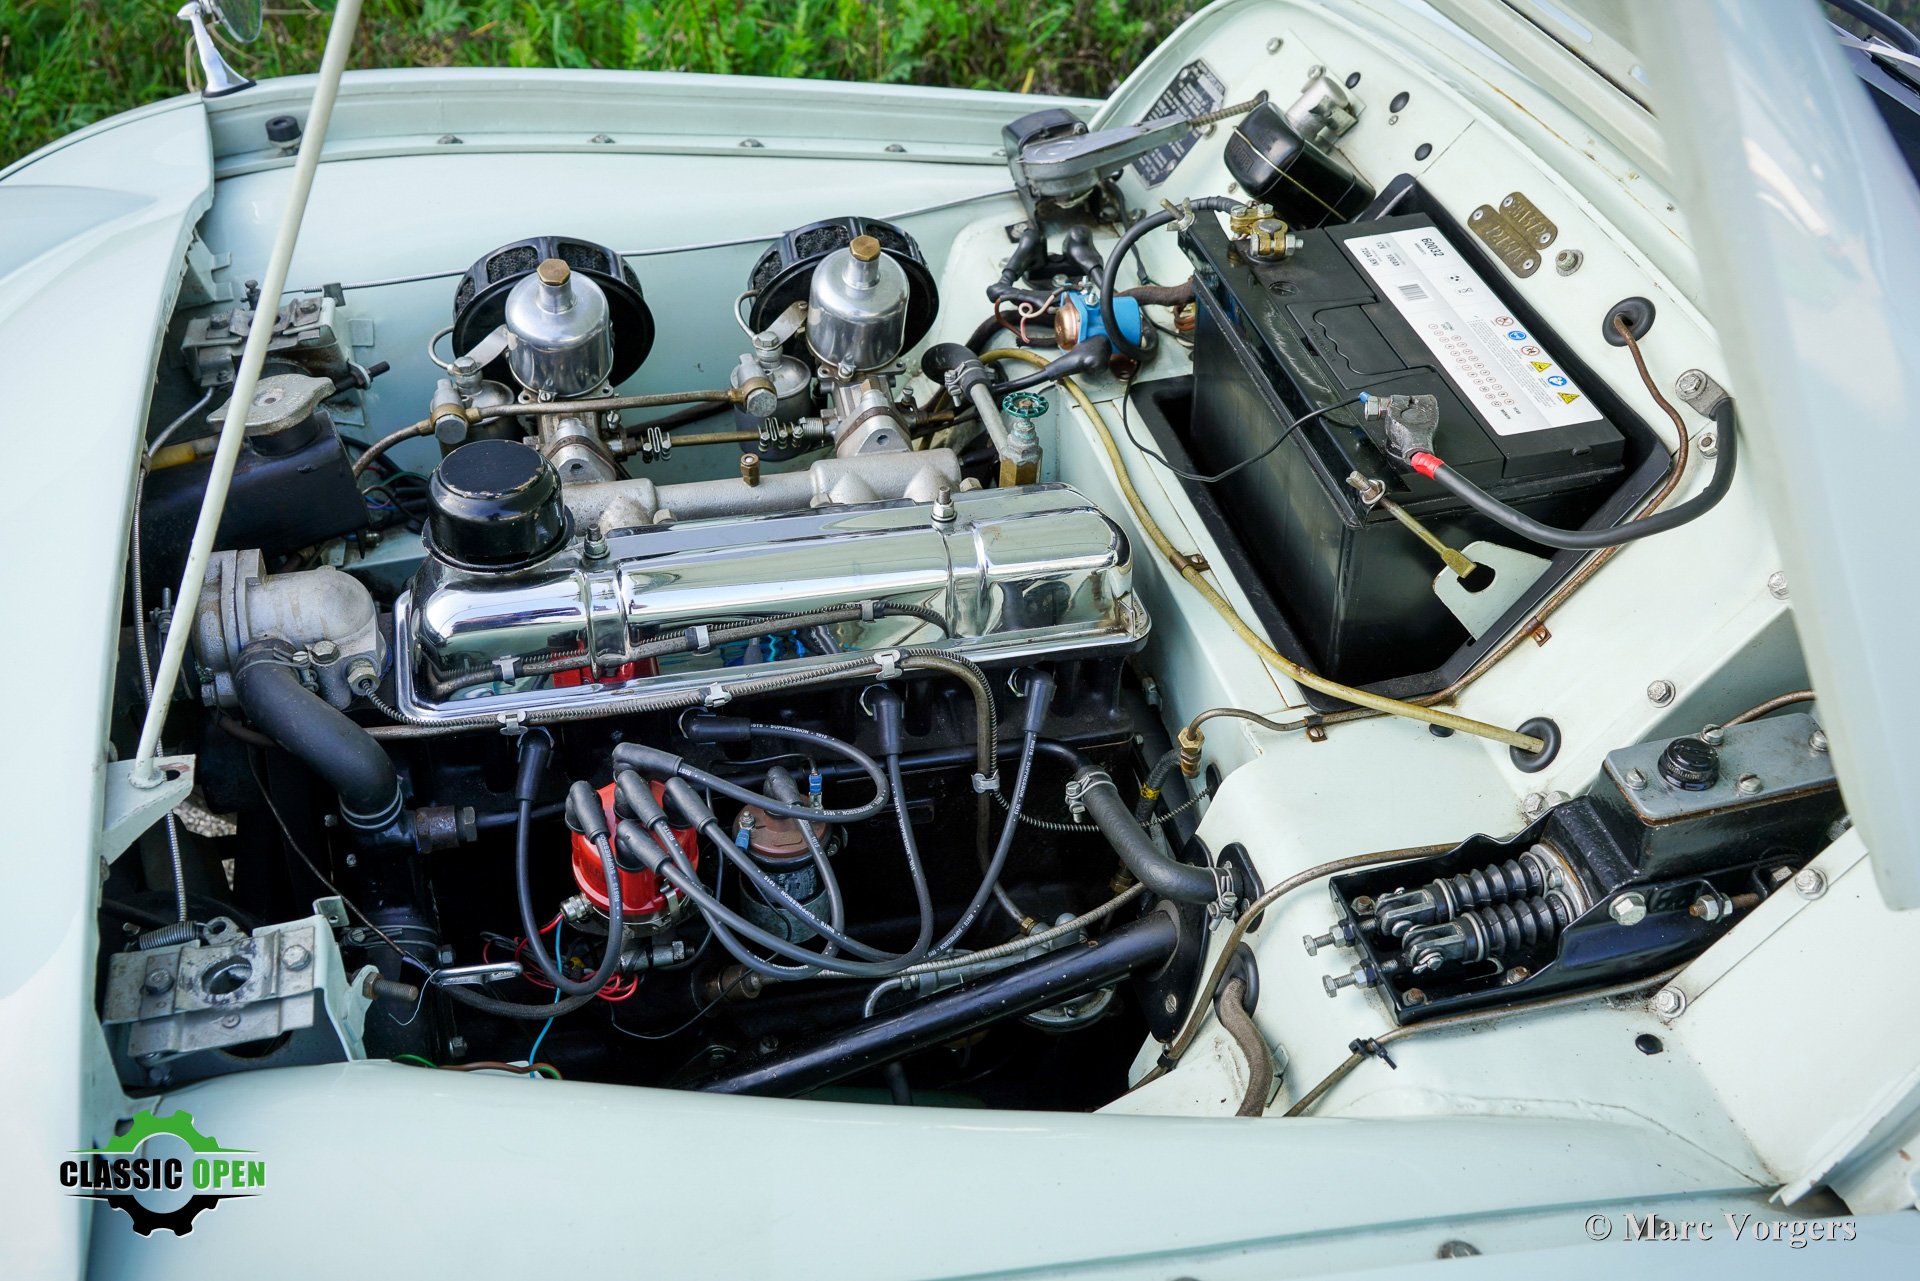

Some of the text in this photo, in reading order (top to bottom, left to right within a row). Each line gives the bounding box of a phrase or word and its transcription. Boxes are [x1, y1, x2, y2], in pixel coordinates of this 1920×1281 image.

[1421, 237, 1445, 257] 60032
[1018, 762, 1031, 798] SUPPRESSION
[810, 836, 821, 848] 1015
[763, 875, 777, 888] 1015
[781, 890, 816, 920] SUPPRESSION
[820, 921, 835, 934] RISTS
[939, 927, 963, 951] SUPPRESSION
